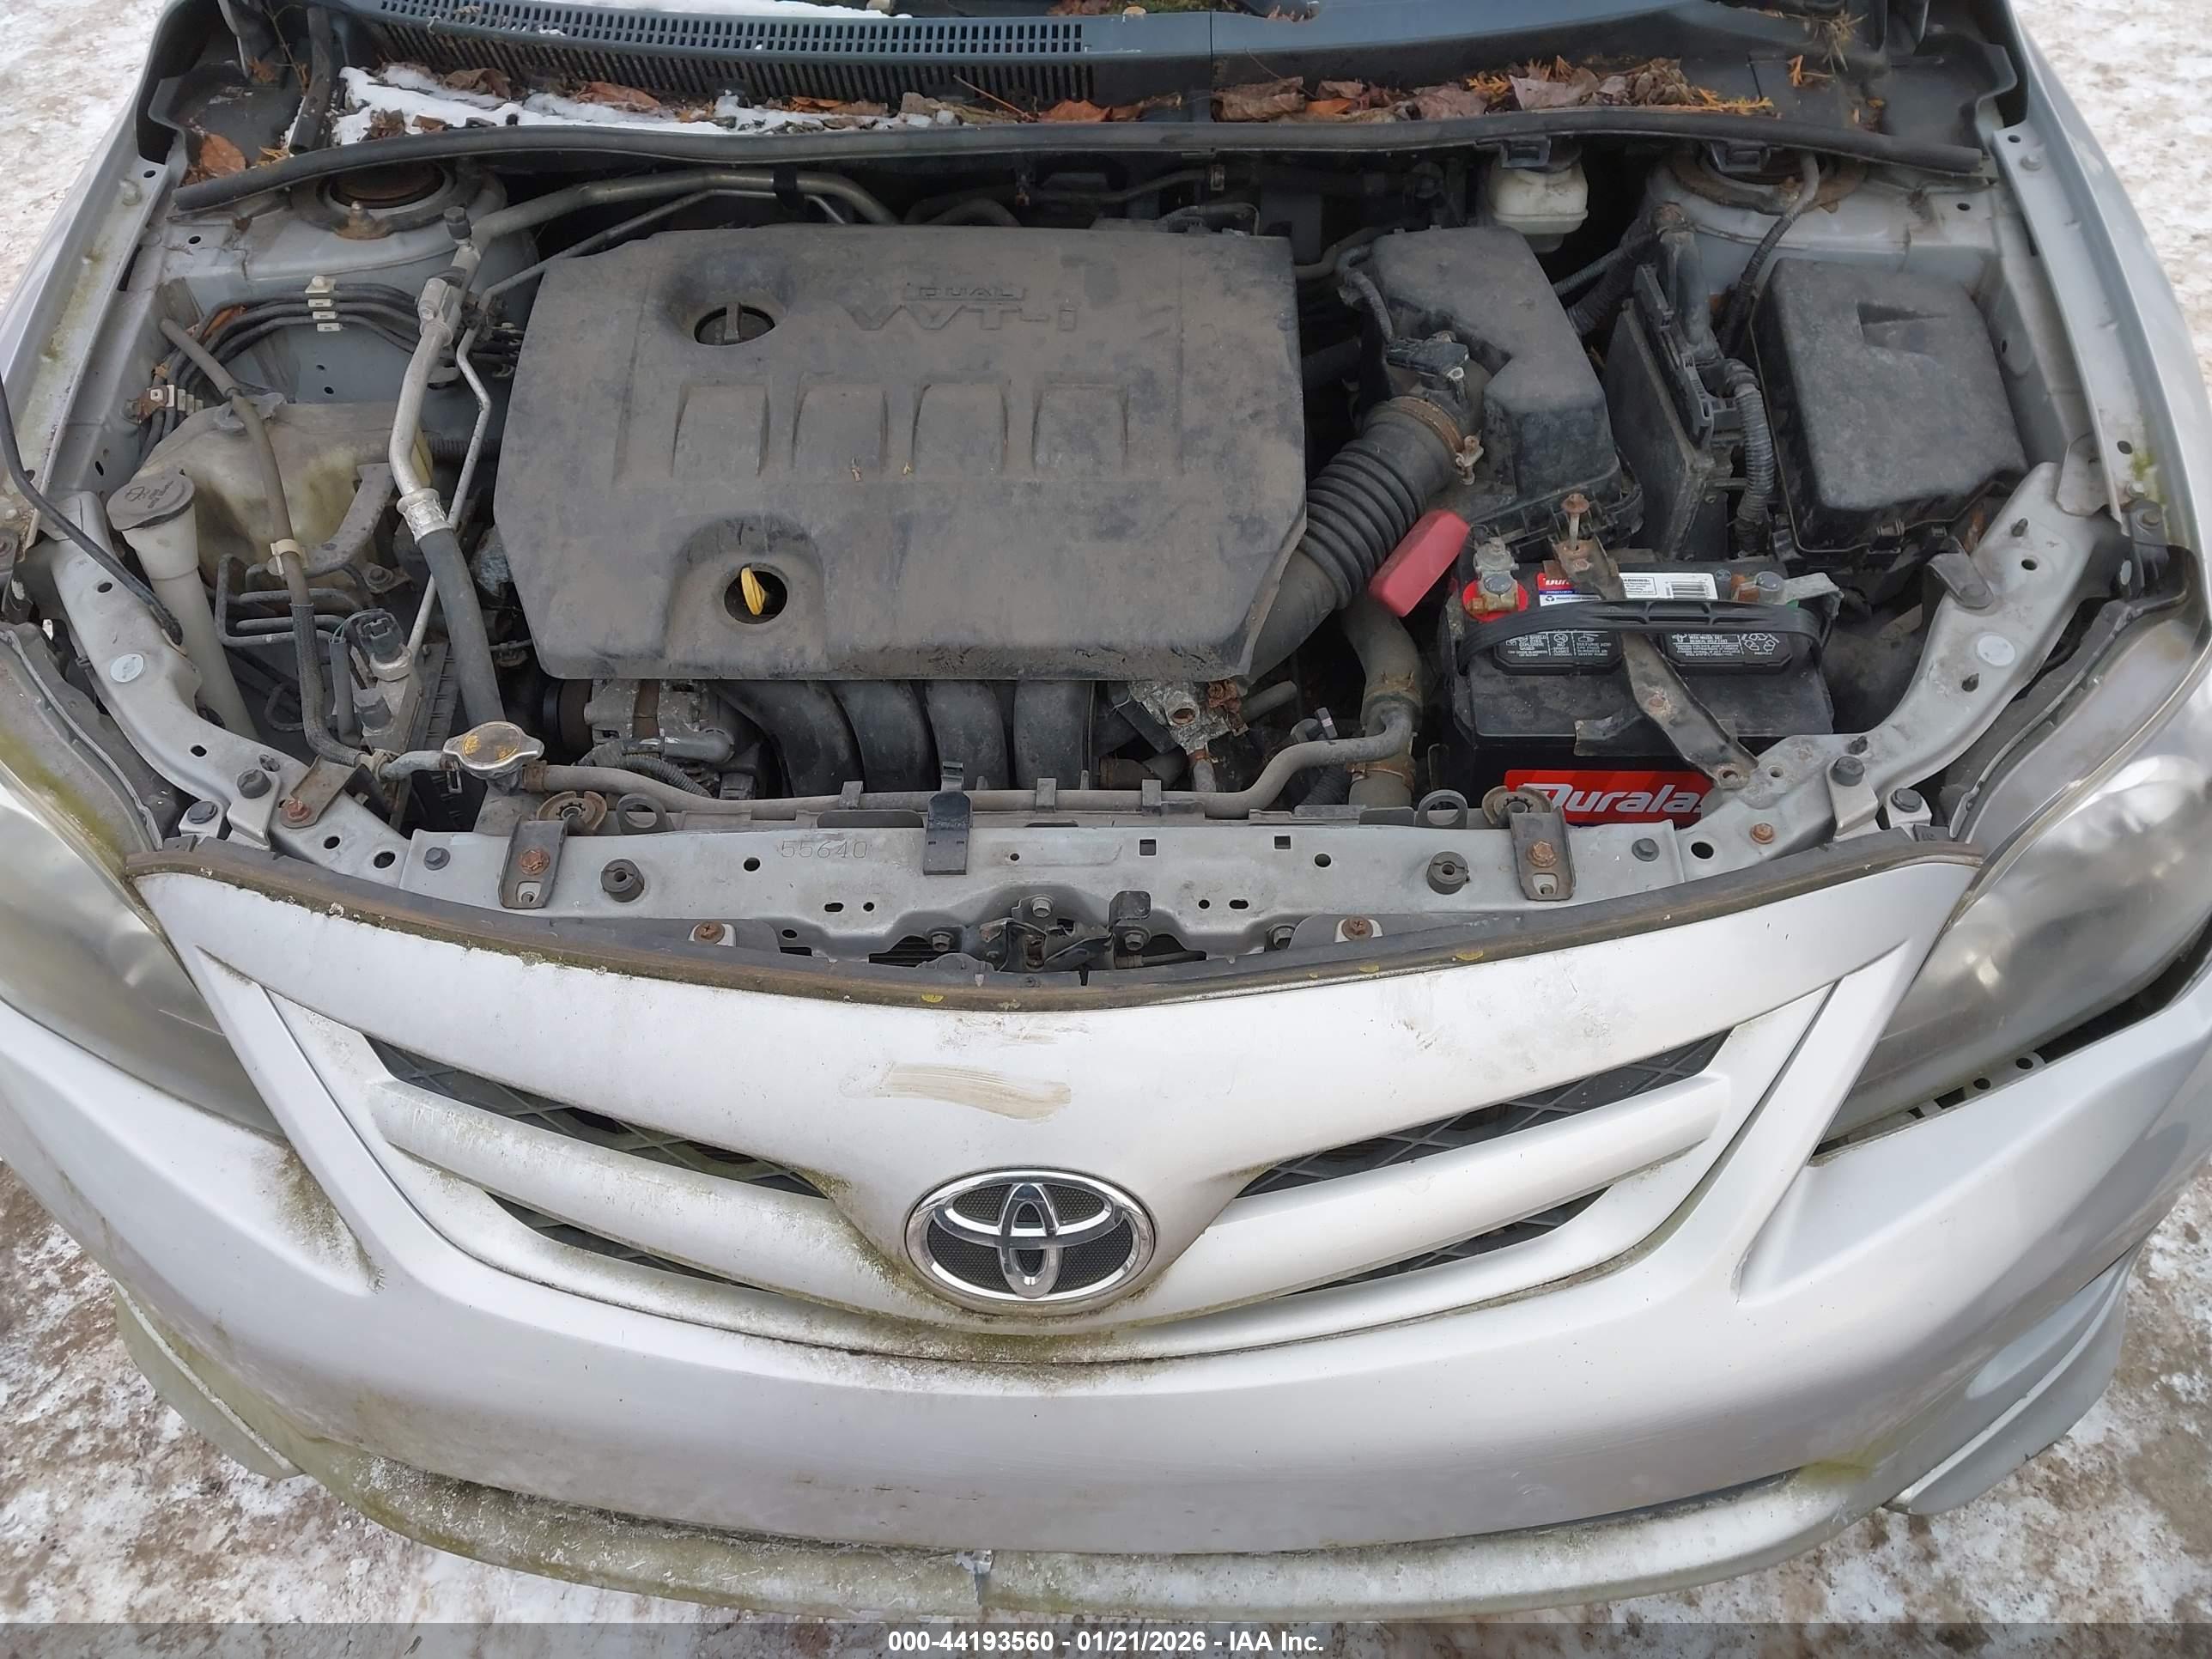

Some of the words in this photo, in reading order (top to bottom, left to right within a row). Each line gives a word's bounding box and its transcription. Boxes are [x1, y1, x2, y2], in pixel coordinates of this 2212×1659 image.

[918, 286, 1015, 298] DUAL
[1522, 782, 1701, 813] Durala
[781, 840, 867, 859] 55640
